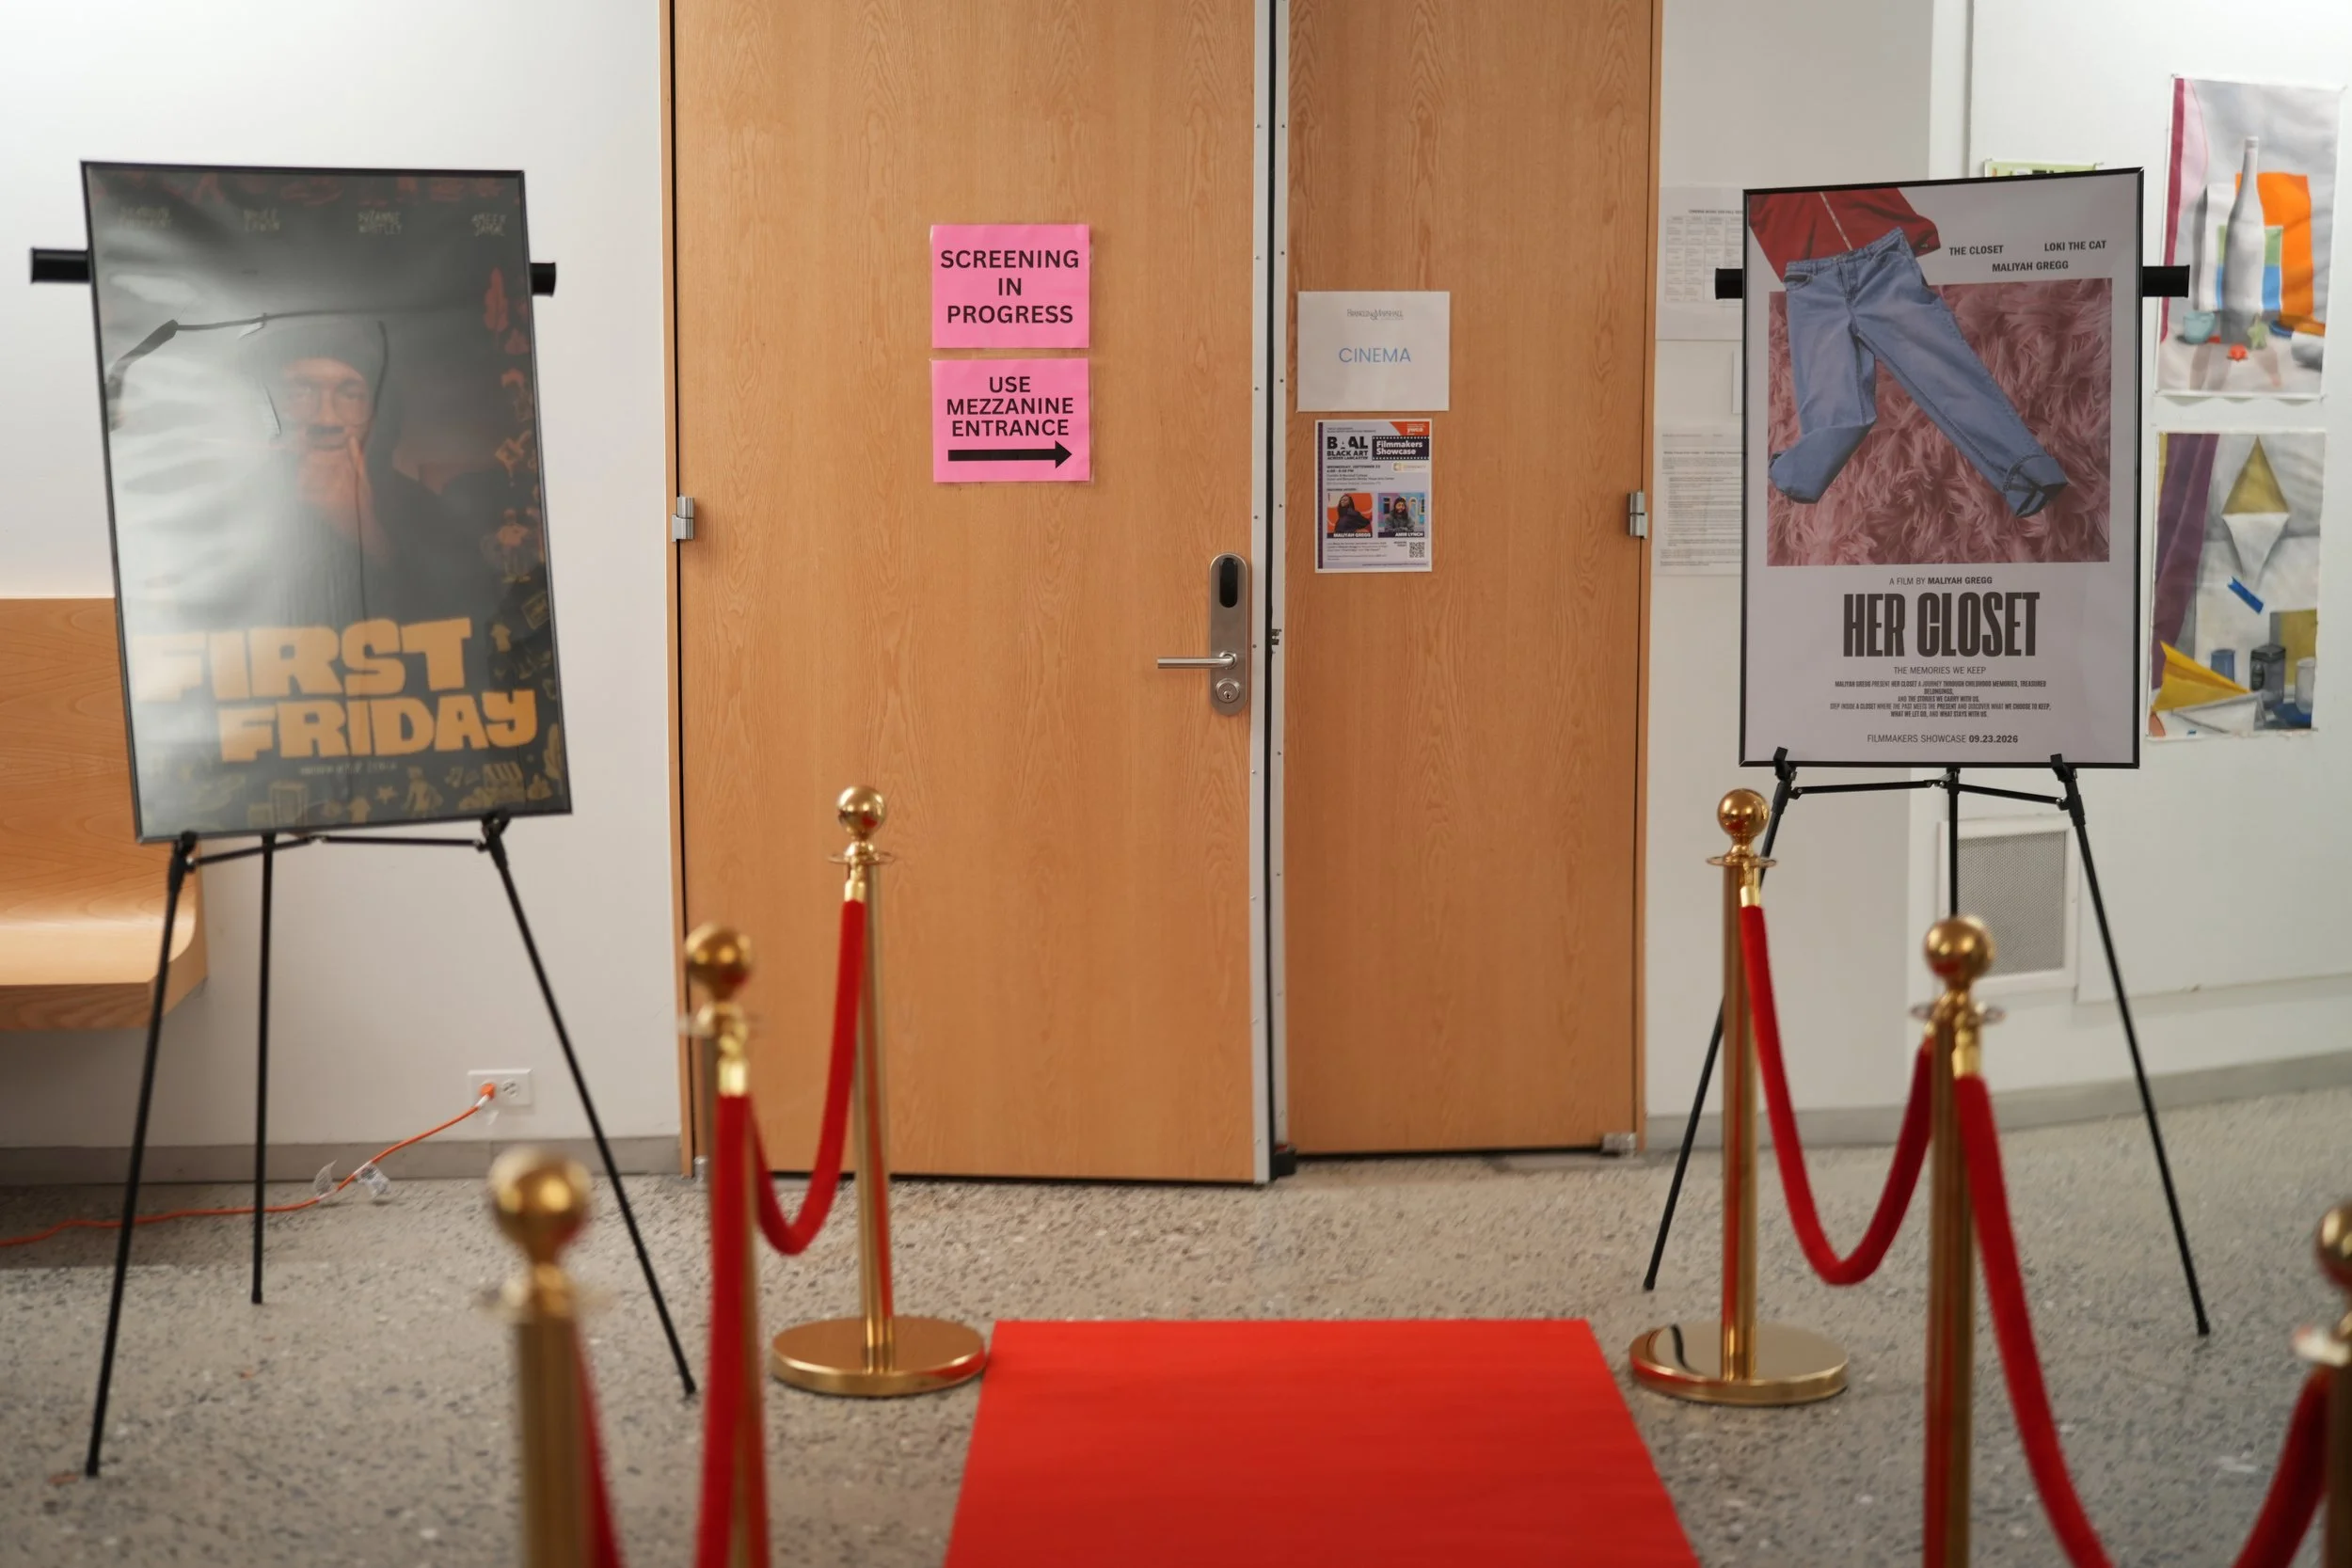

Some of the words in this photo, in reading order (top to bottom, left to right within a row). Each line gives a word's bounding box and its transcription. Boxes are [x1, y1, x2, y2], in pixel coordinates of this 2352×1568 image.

[1969, 245, 2003, 254] CLOSET
[2044, 242, 2065, 251] LOKI
[2069, 242, 2085, 250] THE
[2089, 241, 2106, 249] CAT
[941, 250, 1078, 268] SCREENING
[1993, 262, 2032, 272] MALIYAH
[2036, 261, 2068, 270] GREGG
[999, 278, 1021, 295] IN
[948, 306, 1073, 324] PROGRESS
[1340, 348, 1411, 362] CINEMA
[990, 376, 1030, 392] USE
[947, 398, 1073, 415] MEZZANINE
[953, 420, 1069, 436] ENTRANCE
[1844, 594, 1905, 657] HER
[1917, 592, 2040, 657] CLOSET
[131, 617, 470, 702] FIRST
[217, 689, 537, 762] FRIDAY
[1921, 735, 1965, 743] SHOWCASE
[1969, 735, 2018, 743] 09.23.2026
